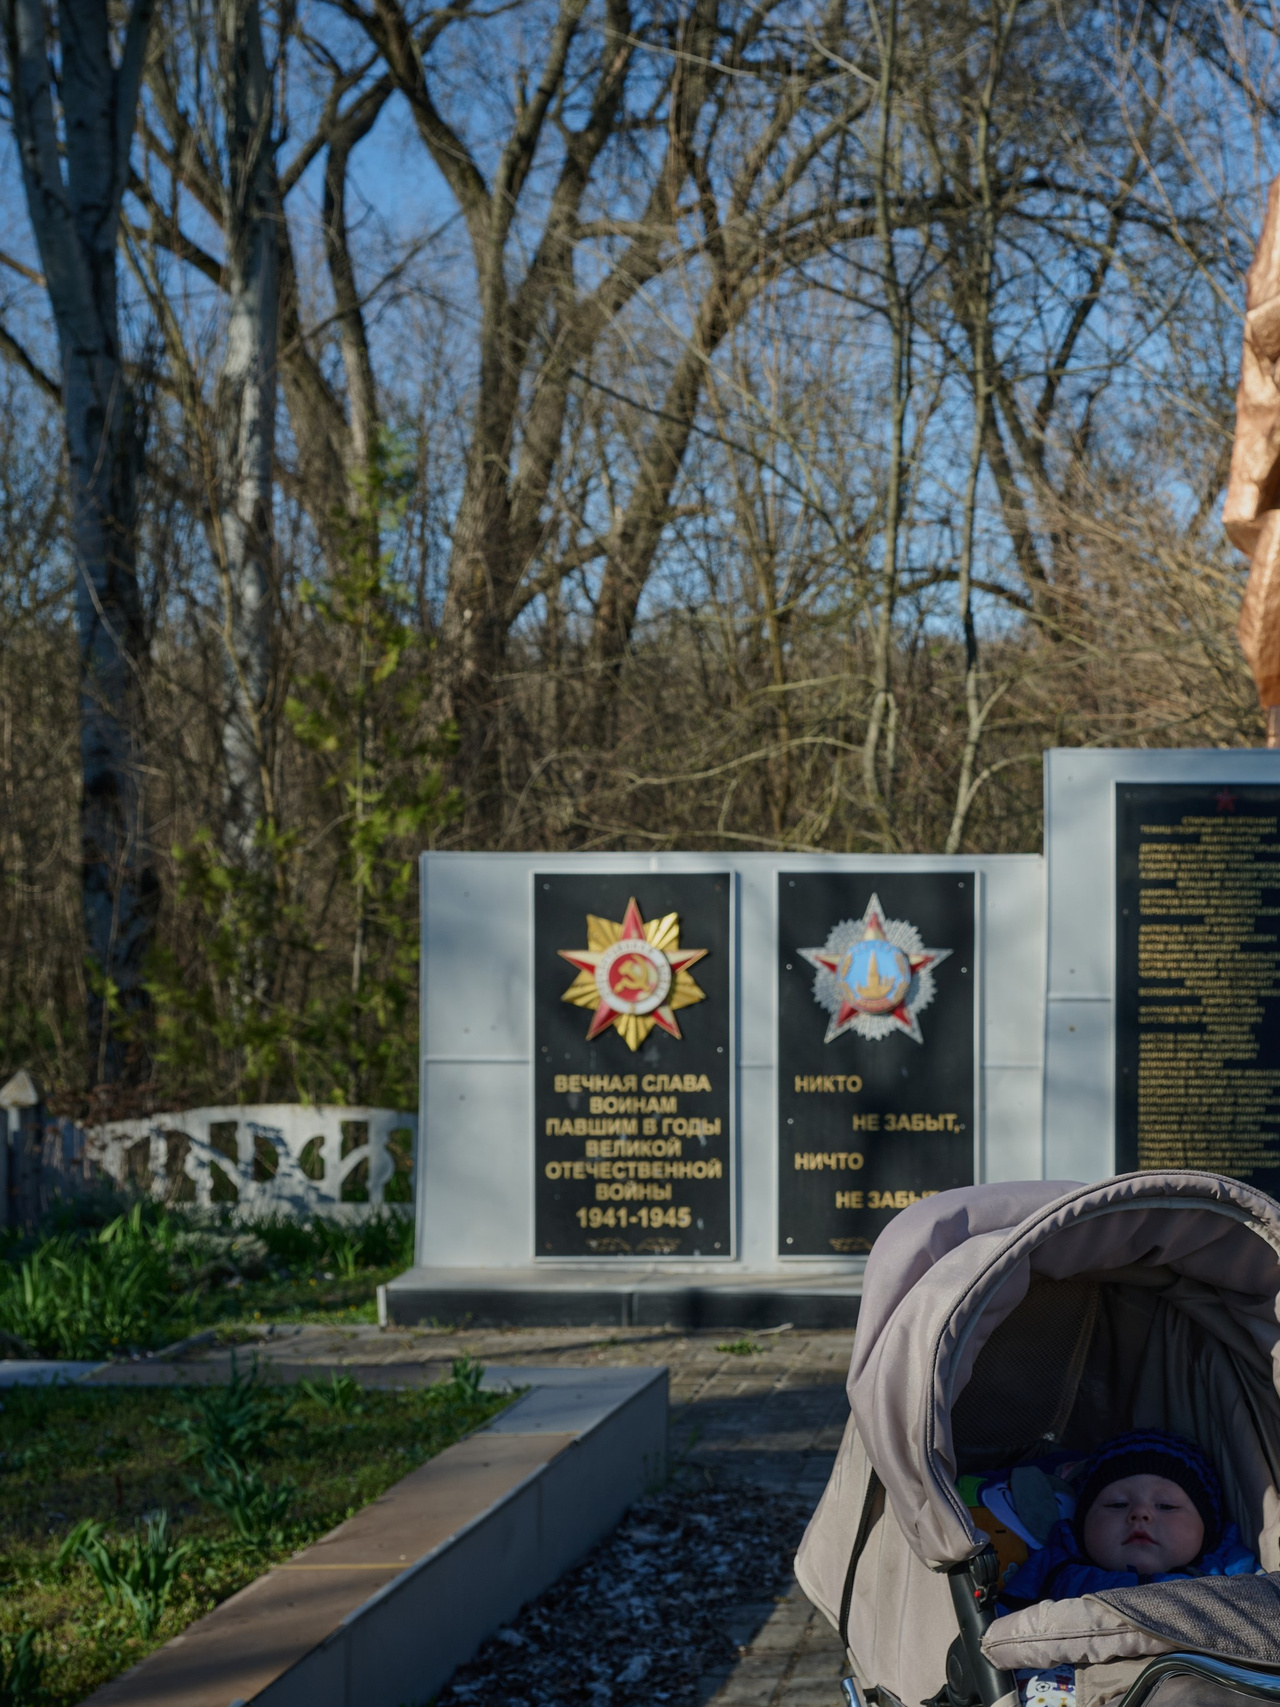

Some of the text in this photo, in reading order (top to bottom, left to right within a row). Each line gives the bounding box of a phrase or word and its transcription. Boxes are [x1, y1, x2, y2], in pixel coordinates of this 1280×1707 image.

[554, 1074, 712, 1093] ВЕЧНАЯ СЛАВА
[794, 1076, 862, 1093] НИКТО
[590, 1097, 677, 1114] ВОИНАМ
[546, 1118, 721, 1137] ПАВШИМ В ГОДЫ
[853, 1114, 960, 1133] НЕ ЗАБЫТ,
[586, 1137, 681, 1158] ВЕЛИКОЙ
[546, 1159, 722, 1180] ОТЕЧЕСТВЕННОЙ
[794, 1153, 863, 1170] НИЧТО
[595, 1180, 671, 1201] ВОЙНЫ
[836, 1191, 941, 1208] НЕ ЗАБЫ
[576, 1207, 691, 1228] 1941-1945
